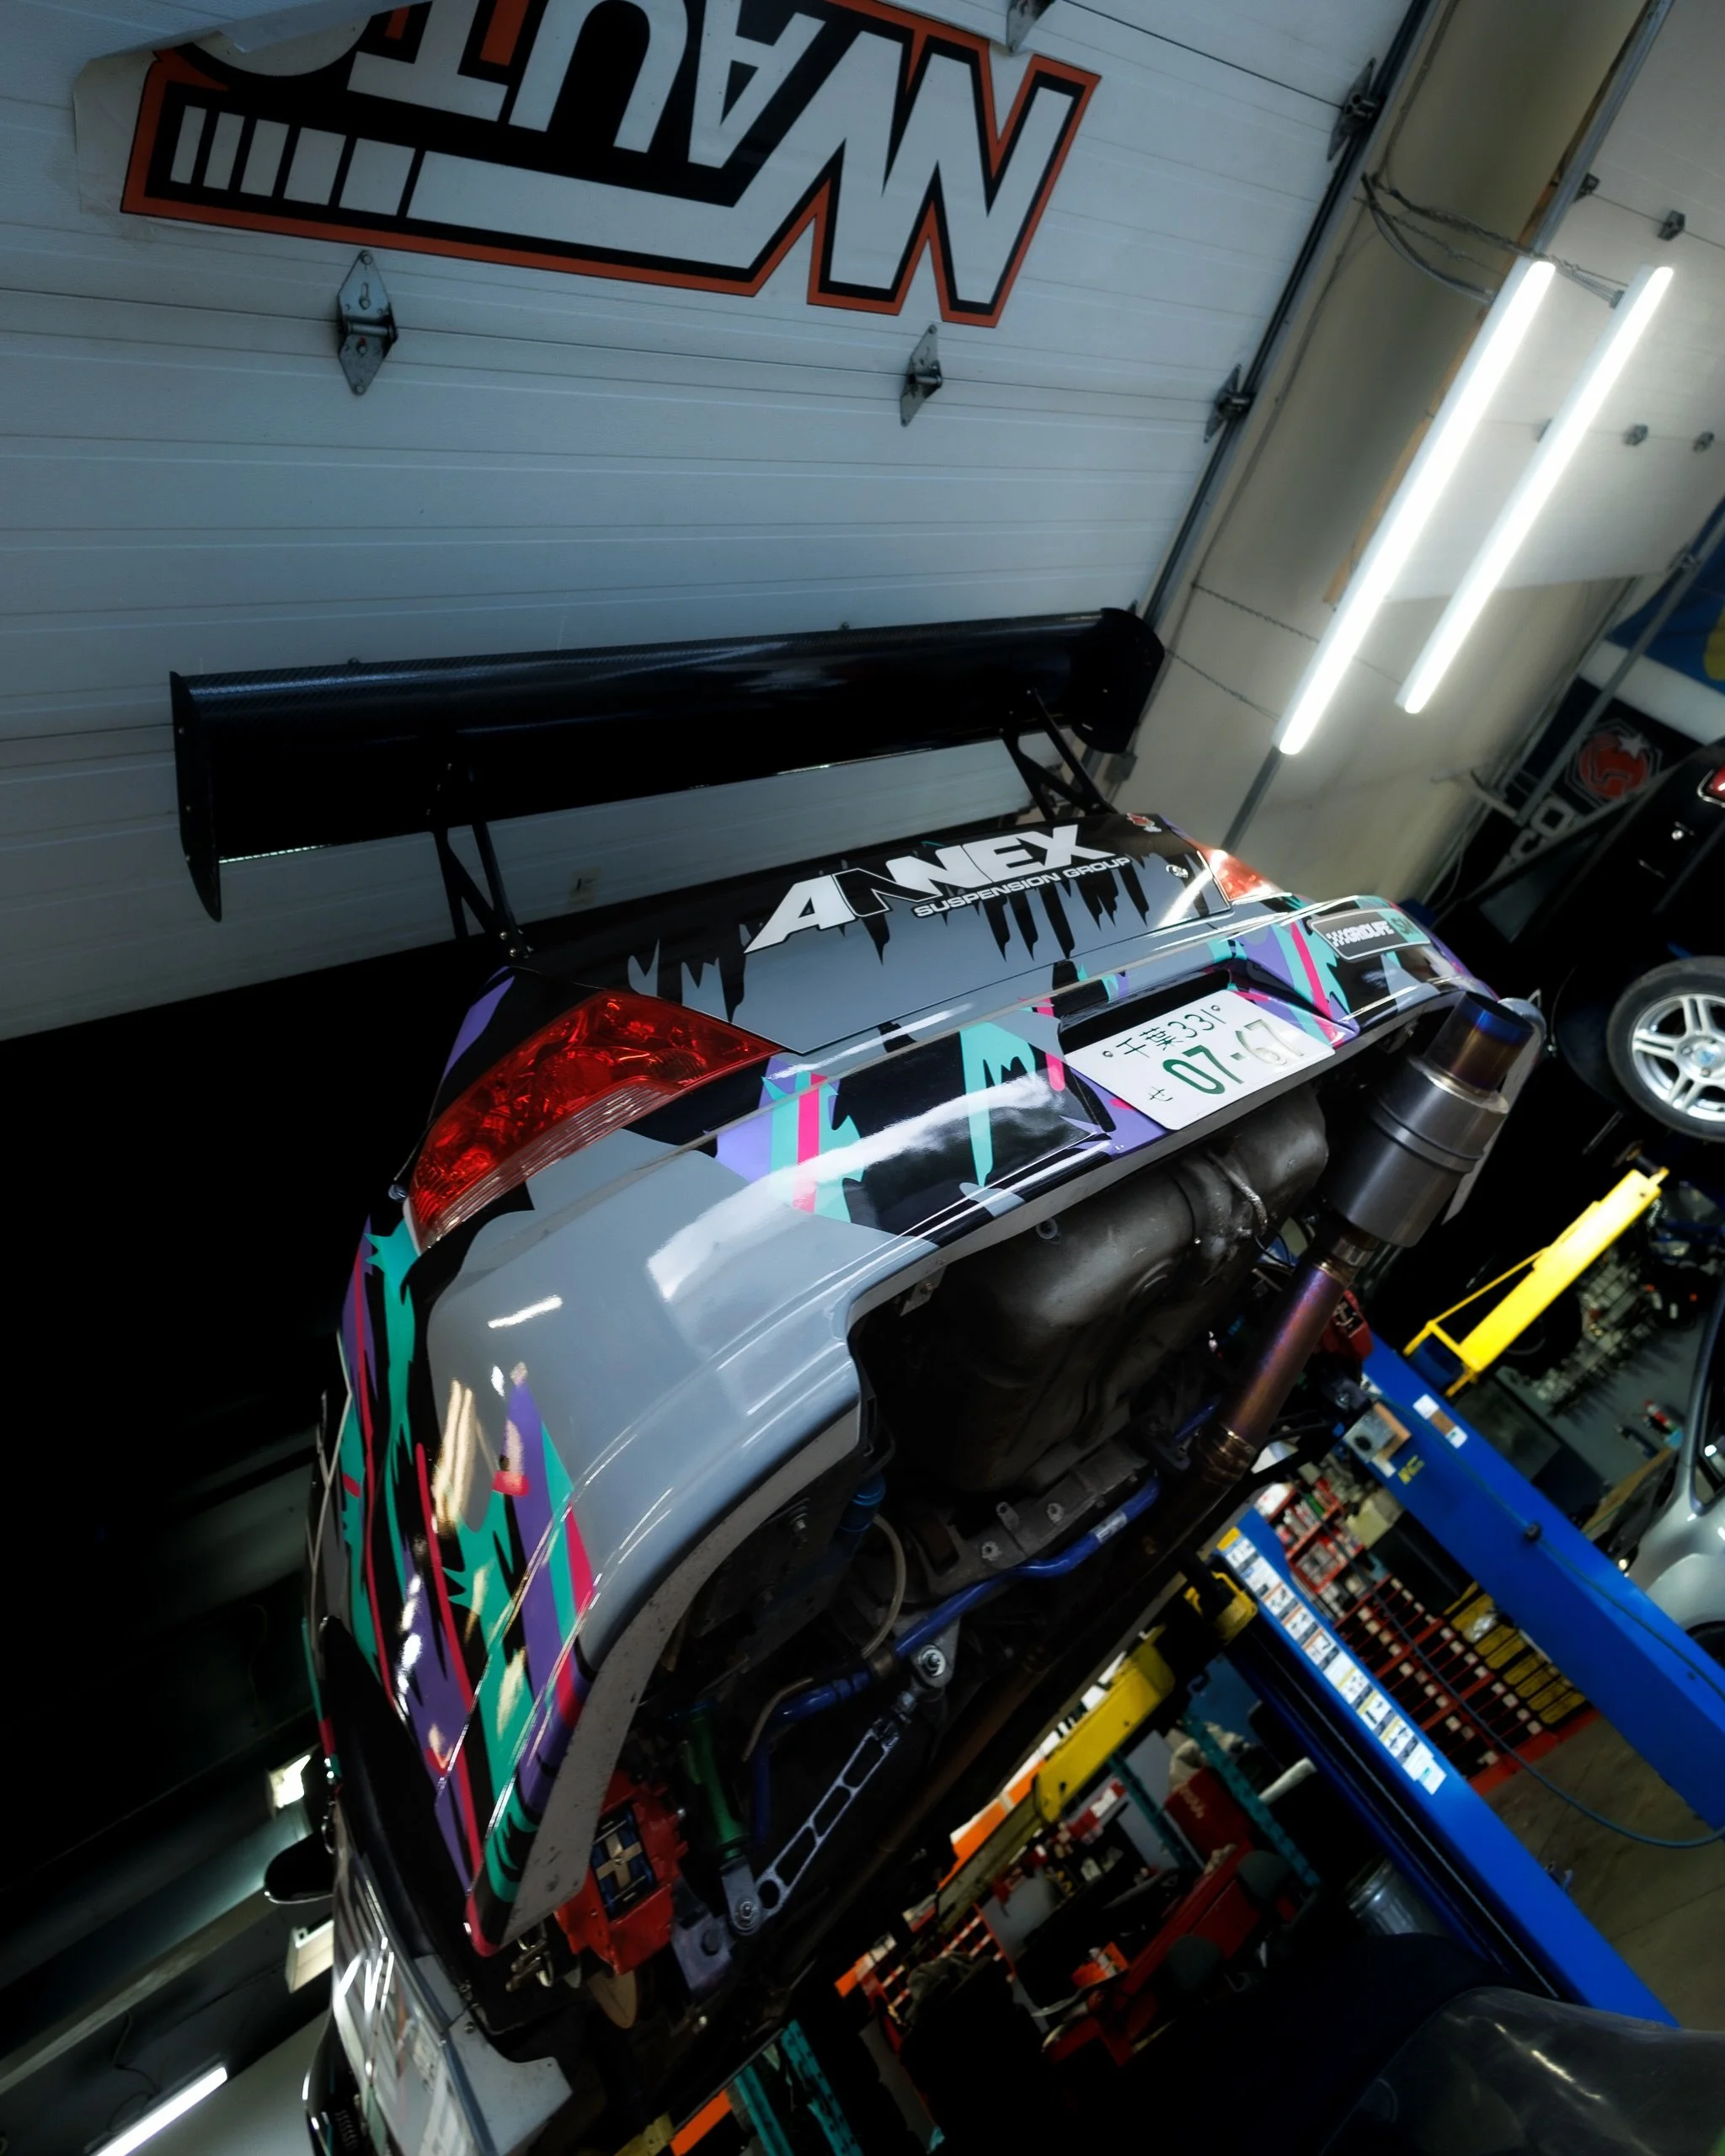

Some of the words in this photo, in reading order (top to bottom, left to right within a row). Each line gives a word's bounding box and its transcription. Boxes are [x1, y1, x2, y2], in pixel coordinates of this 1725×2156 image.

[743, 825, 1117, 953] ANNEX
[1062, 857, 1131, 878] GROUP
[1162, 1019, 1305, 1095] 07-67
